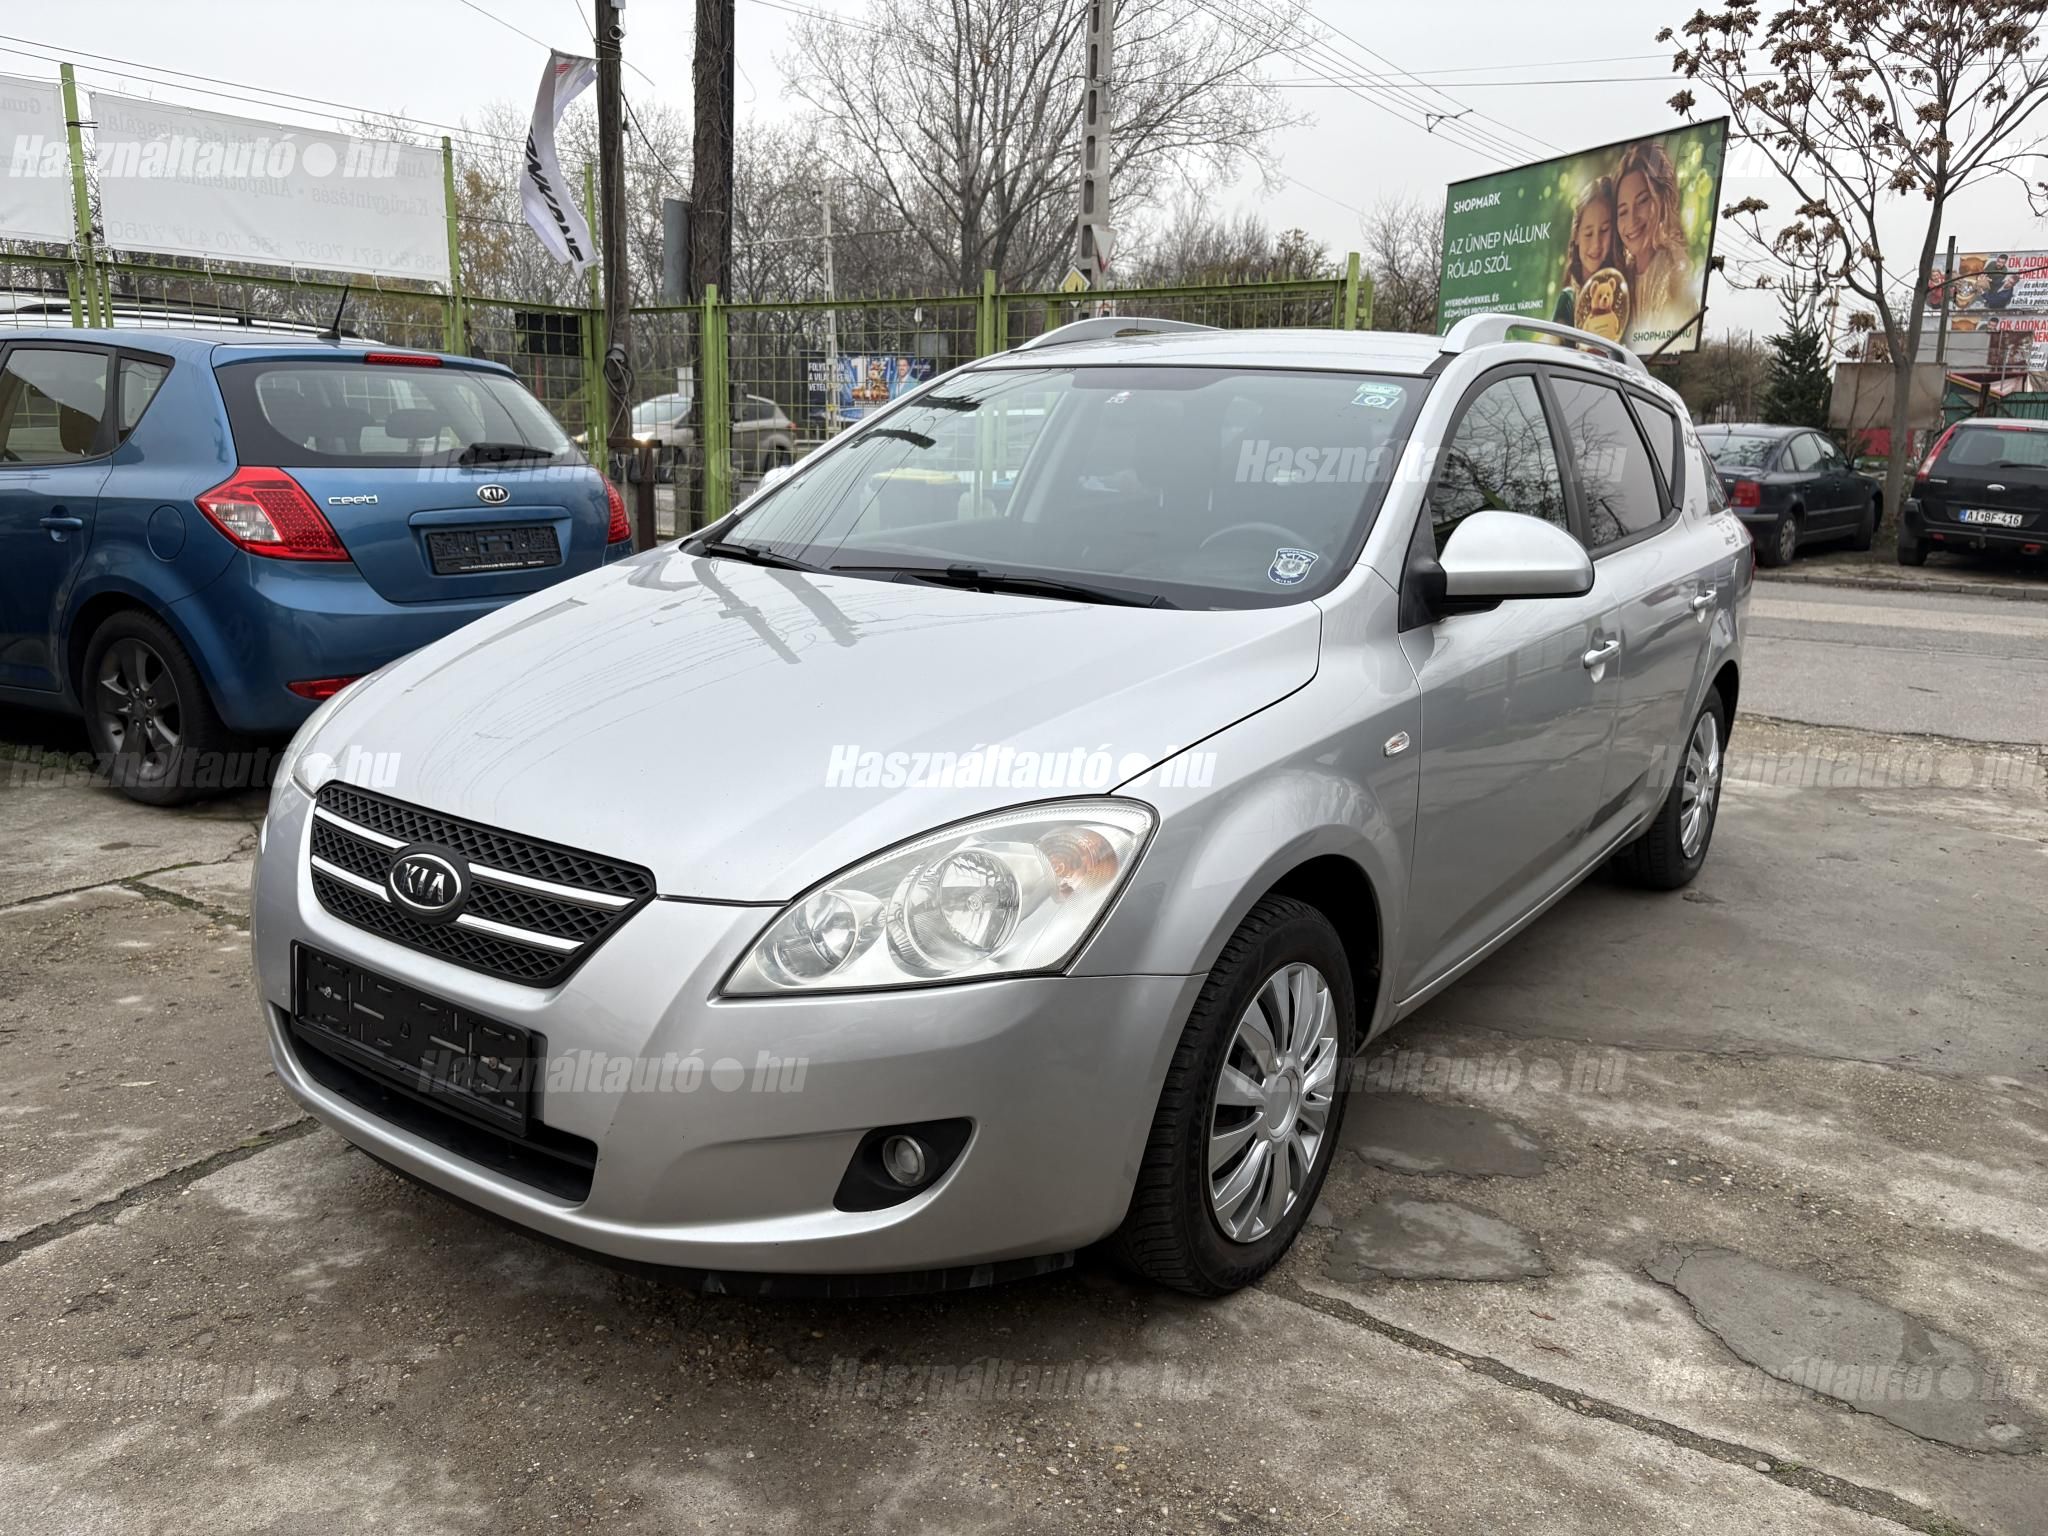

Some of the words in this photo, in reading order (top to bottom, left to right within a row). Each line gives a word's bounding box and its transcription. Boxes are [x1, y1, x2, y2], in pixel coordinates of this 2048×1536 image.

[1453, 191, 1502, 215] SHOPMARK
[1449, 238, 1463, 256] AZ
[1466, 229, 1501, 253] ÜNNEP
[1502, 222, 1552, 247] NÁLUNK
[1447, 257, 1483, 280] RÓLAD
[1484, 252, 1512, 274] SZÓL
[1492, 292, 1500, 302] ÉS
[1517, 299, 1544, 310] VÁRUNK!
[483, 487, 505, 499] KIA
[400, 863, 447, 907] KIA
